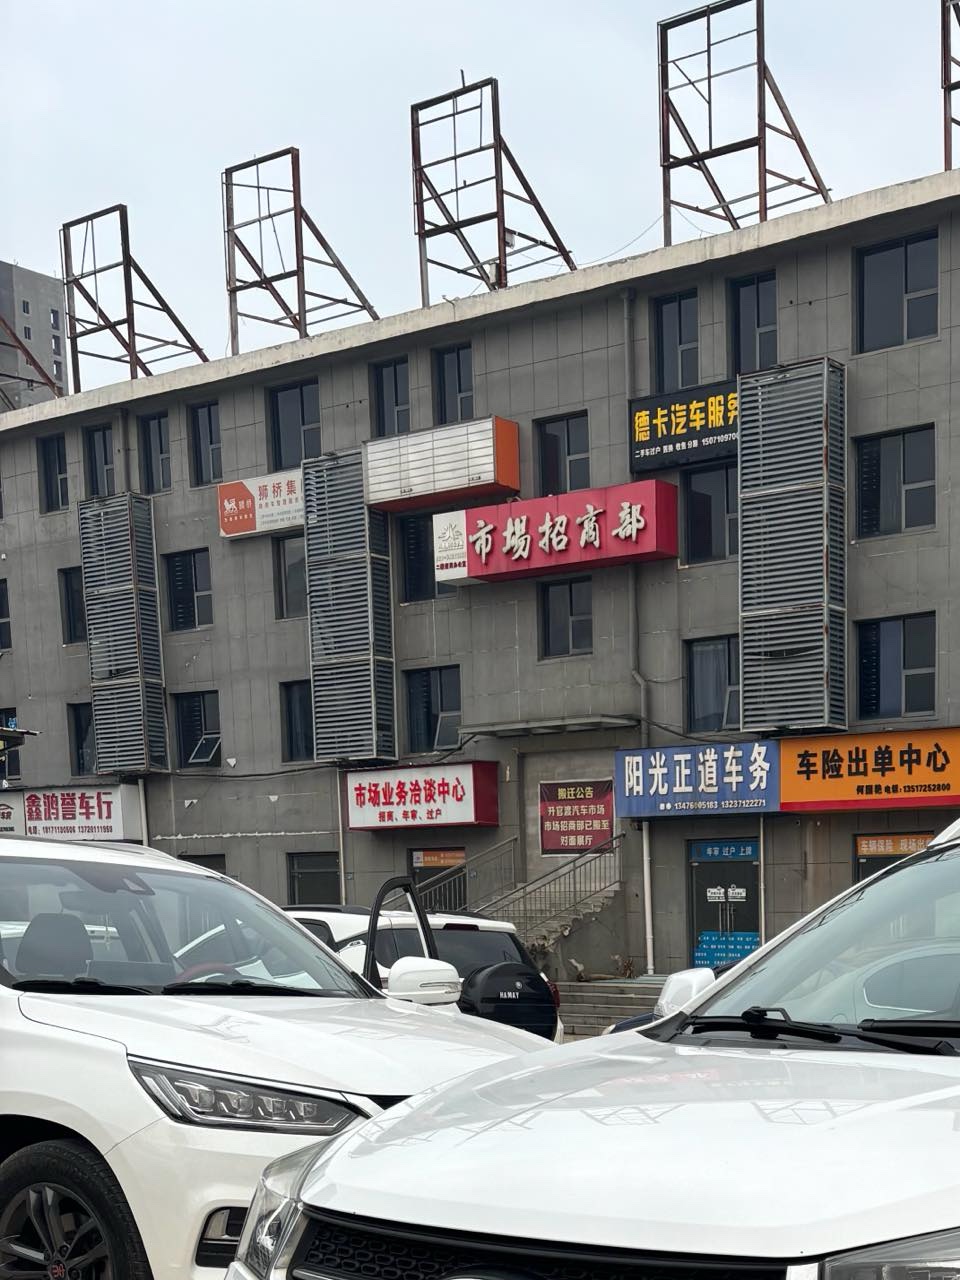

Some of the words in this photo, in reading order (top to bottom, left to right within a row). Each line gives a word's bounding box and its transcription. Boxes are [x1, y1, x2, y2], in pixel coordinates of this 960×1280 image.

[625, 742, 770, 797] 阳光正道车务
[797, 743, 950, 781] 车险出单中心
[26, 791, 113, 821] 鑫鸿誉车行
[354, 776, 466, 808] 市场业务洽谈中心
[557, 786, 594, 800] 搬迁公告
[560, 835, 593, 847] 对面展厅
